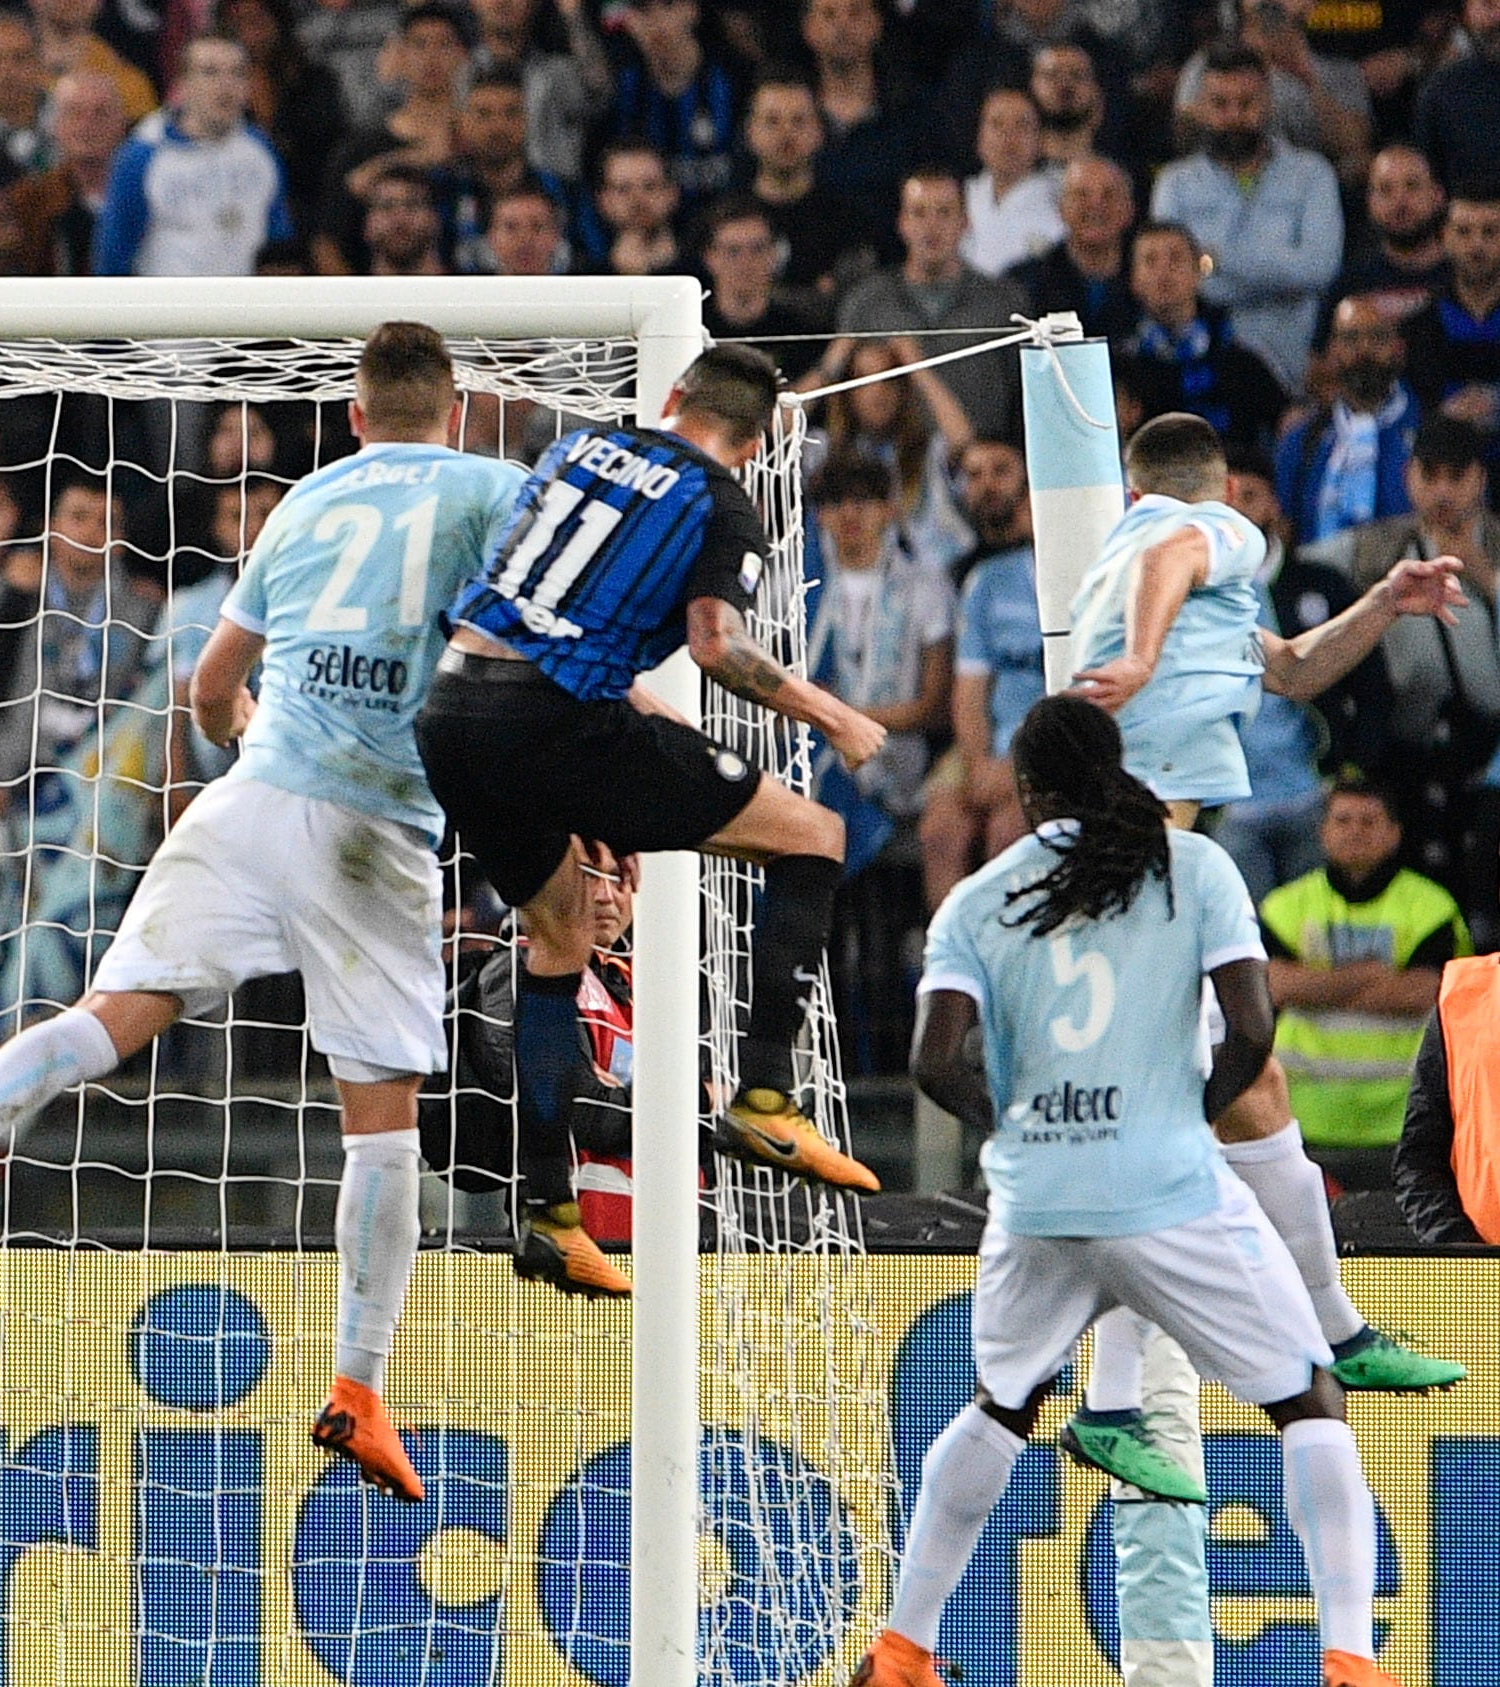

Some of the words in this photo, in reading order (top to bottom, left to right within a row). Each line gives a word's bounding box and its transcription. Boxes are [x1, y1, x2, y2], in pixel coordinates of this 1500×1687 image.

[565, 434, 680, 500] VECINO
[304, 494, 439, 632] 21
[498, 478, 623, 609] 11
[1051, 932, 1116, 1051] 5
